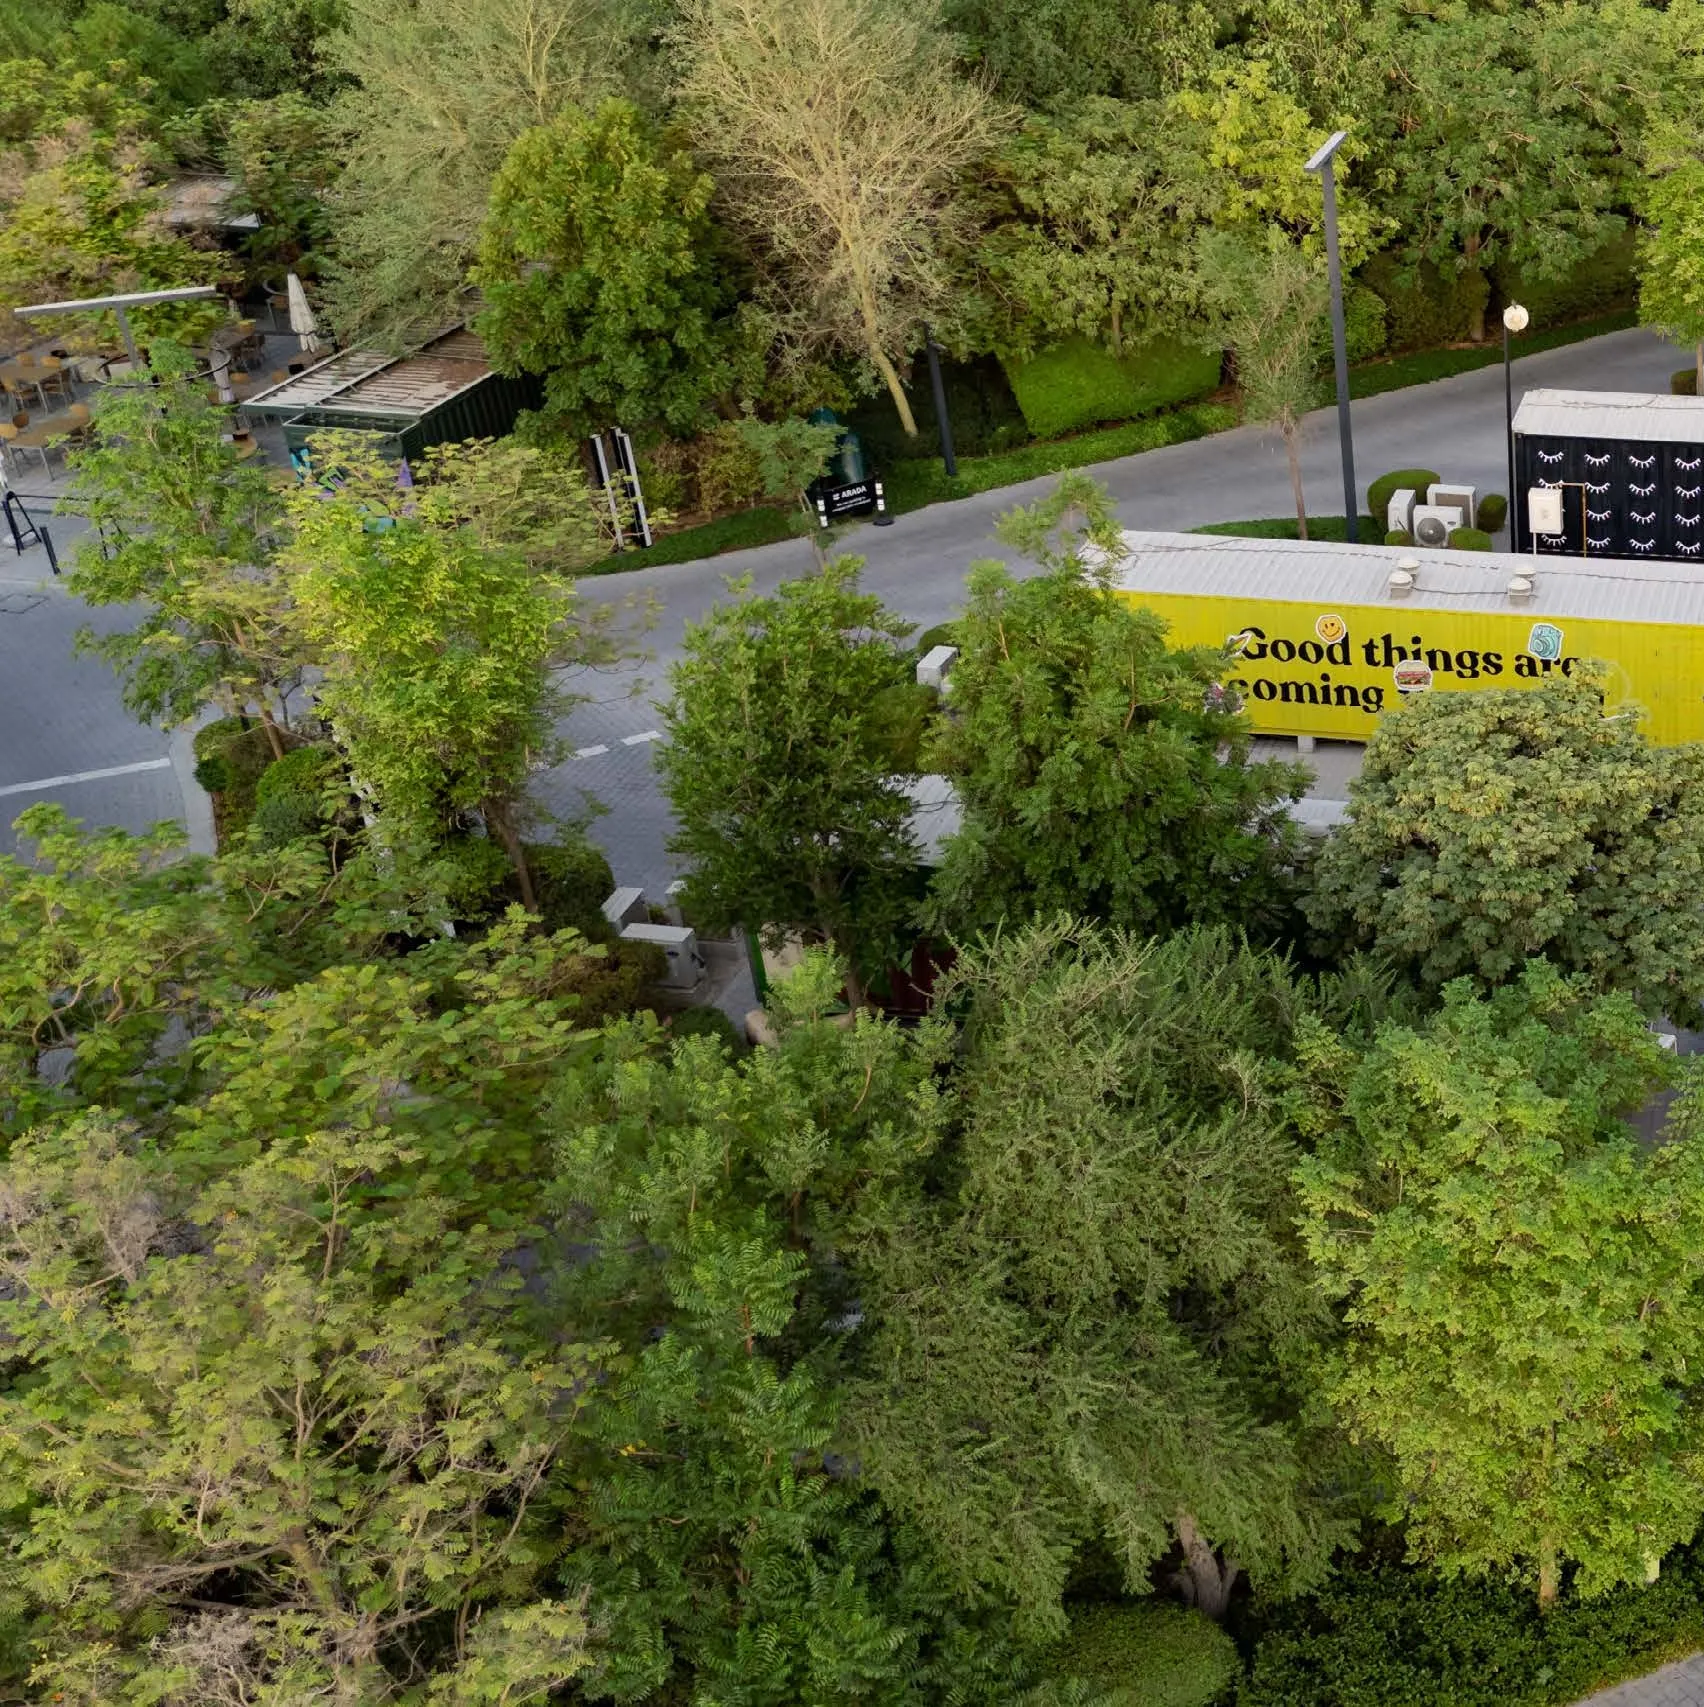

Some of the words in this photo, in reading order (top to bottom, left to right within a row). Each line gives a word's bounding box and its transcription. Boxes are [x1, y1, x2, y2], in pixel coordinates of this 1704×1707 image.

[841, 485, 868, 498] ARADA
[1239, 626, 1352, 666] Good
[1361, 632, 1504, 678] things
